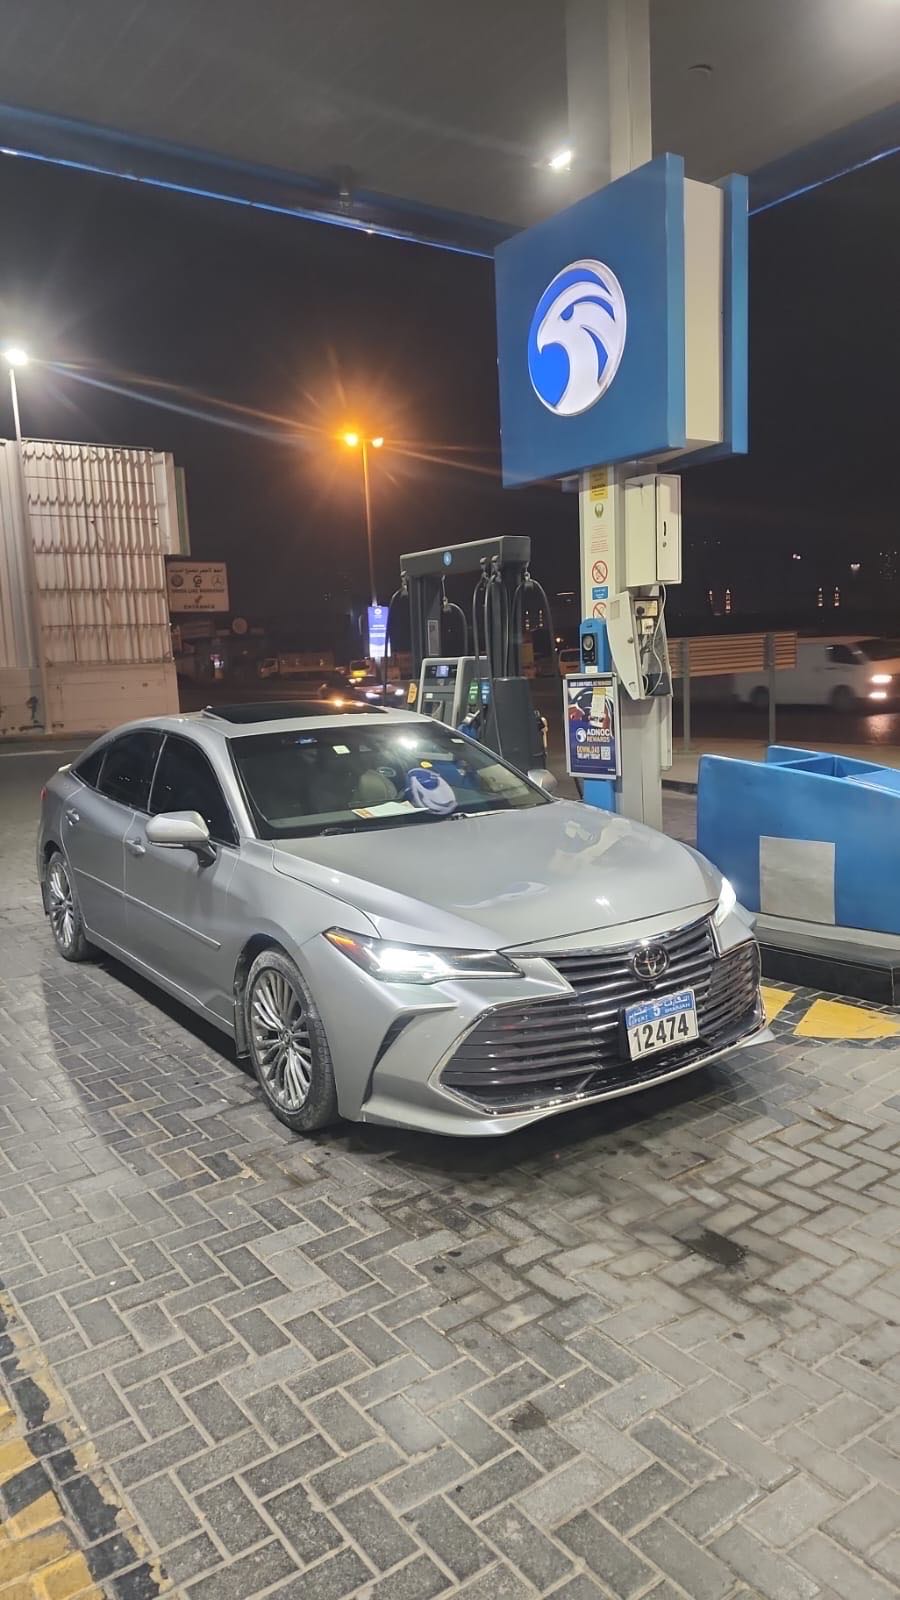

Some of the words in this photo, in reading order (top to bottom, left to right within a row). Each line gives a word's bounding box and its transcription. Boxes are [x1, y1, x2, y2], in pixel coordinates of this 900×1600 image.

[586, 728, 610, 737] ADNOC
[664, 1003, 691, 1014] SHARJAH
[633, 1012, 689, 1052] 12474
